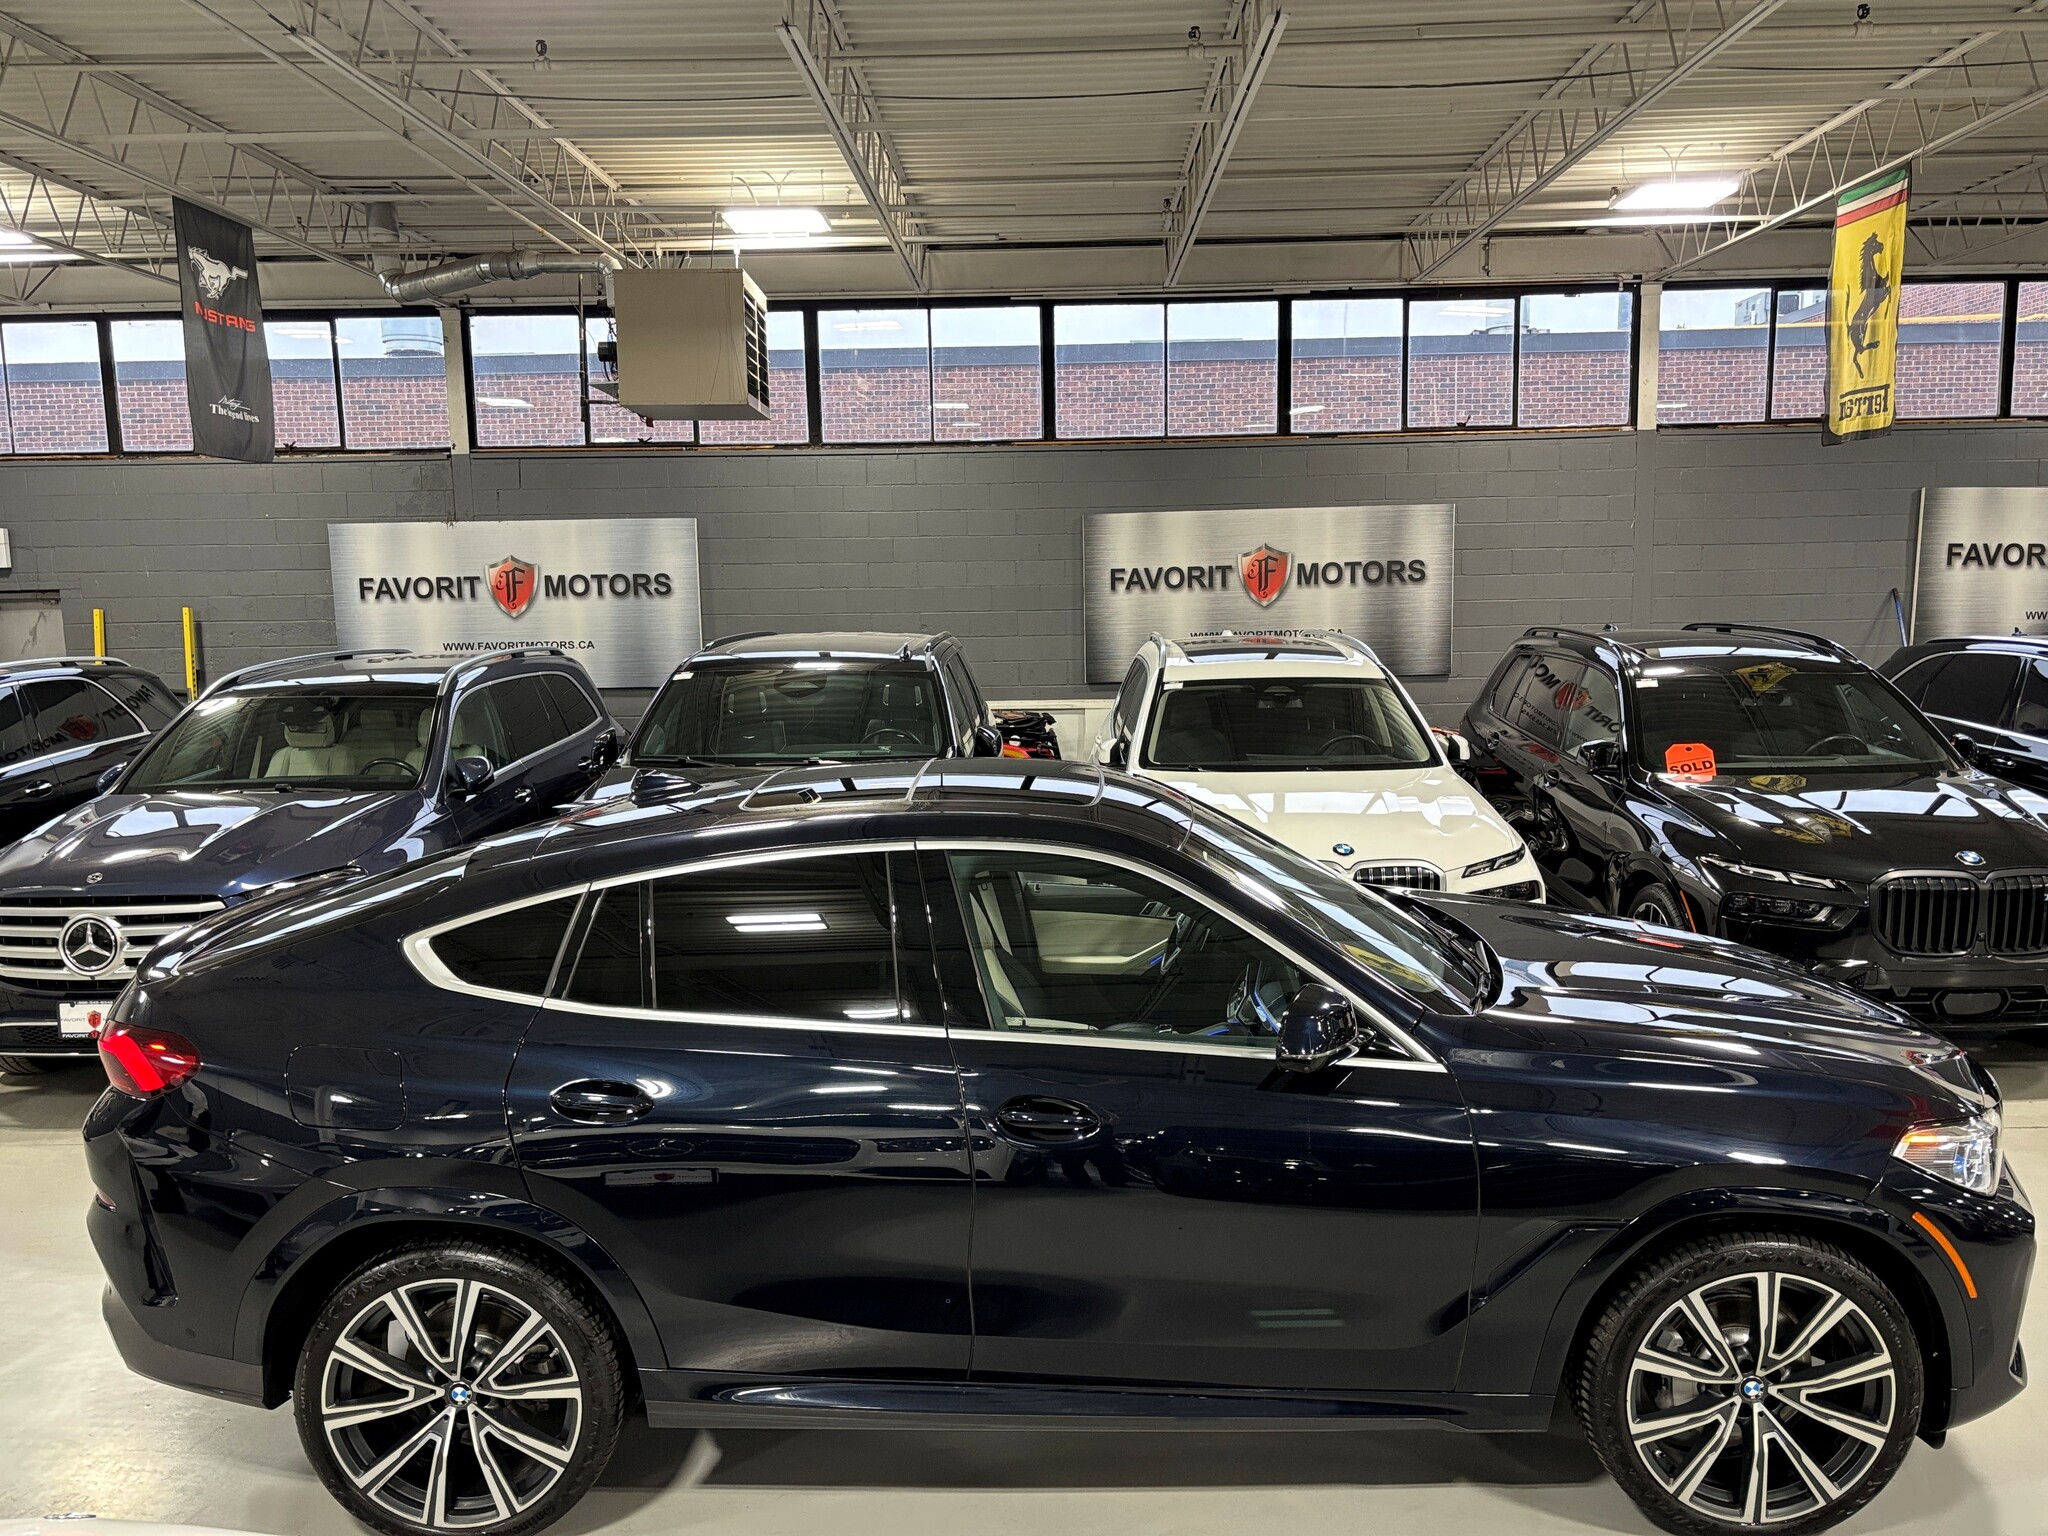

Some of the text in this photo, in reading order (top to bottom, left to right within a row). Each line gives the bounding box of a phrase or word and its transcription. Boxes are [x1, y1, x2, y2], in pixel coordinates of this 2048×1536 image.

[209, 404, 227, 416] The
[1946, 543, 2046, 566] FAVOR
[1110, 565, 1233, 590] FAVORIT
[1297, 560, 1426, 585] MOTORS
[358, 576, 480, 600] FAVORIT
[544, 573, 672, 597] MOTORS
[442, 641, 596, 651] WWW.FAVORITMOTORS.CA
[1669, 760, 1714, 774] SOLD
